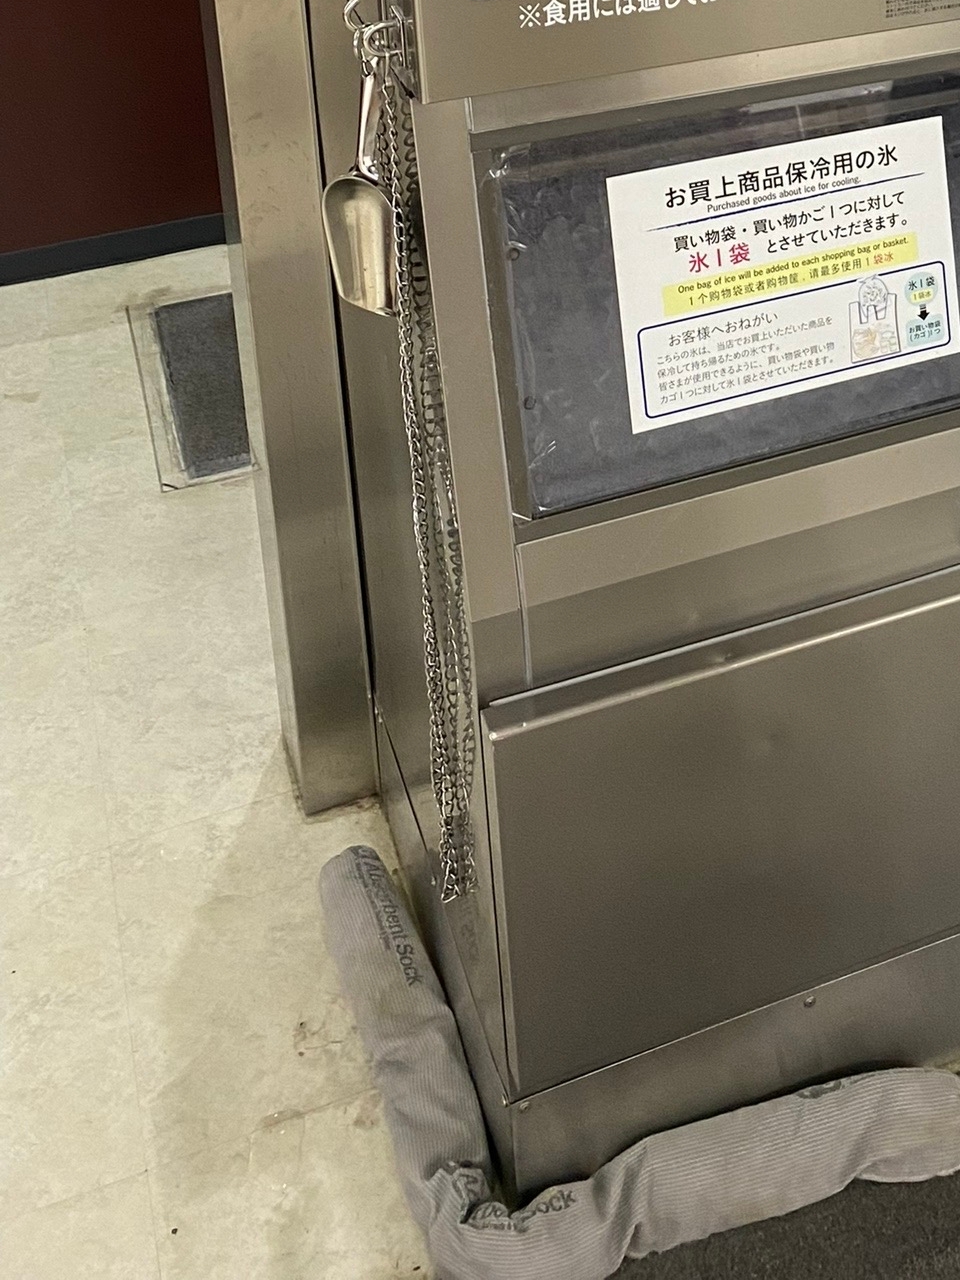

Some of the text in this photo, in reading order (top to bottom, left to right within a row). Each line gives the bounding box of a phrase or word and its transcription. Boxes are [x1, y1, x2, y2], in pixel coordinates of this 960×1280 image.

[665, 143, 899, 209] お買上商品保冷用の氷
[706, 174, 862, 214] Purchased goods about ice for cooling.
[673, 191, 905, 253] 買い物袋・買い物かご1つに対して
[688, 213, 908, 274] 氷1袋 とさせていただきます。
[678, 236, 909, 294] One bag of ice will be added to each shopping bag or basket.
[908, 275, 935, 291] 氷1袋
[656, 316, 833, 366] こちらの氷は、当店でお買上いただいた商品を
[668, 312, 778, 347] お客様へおねがい
[909, 320, 942, 334] お買い物袋
[657, 344, 780, 378] 保冷して持ち帰るための氷です。
[658, 341, 836, 393] 皆さまが使用できるように、買い物袋や買い物
[396, 943, 423, 987] Sock
